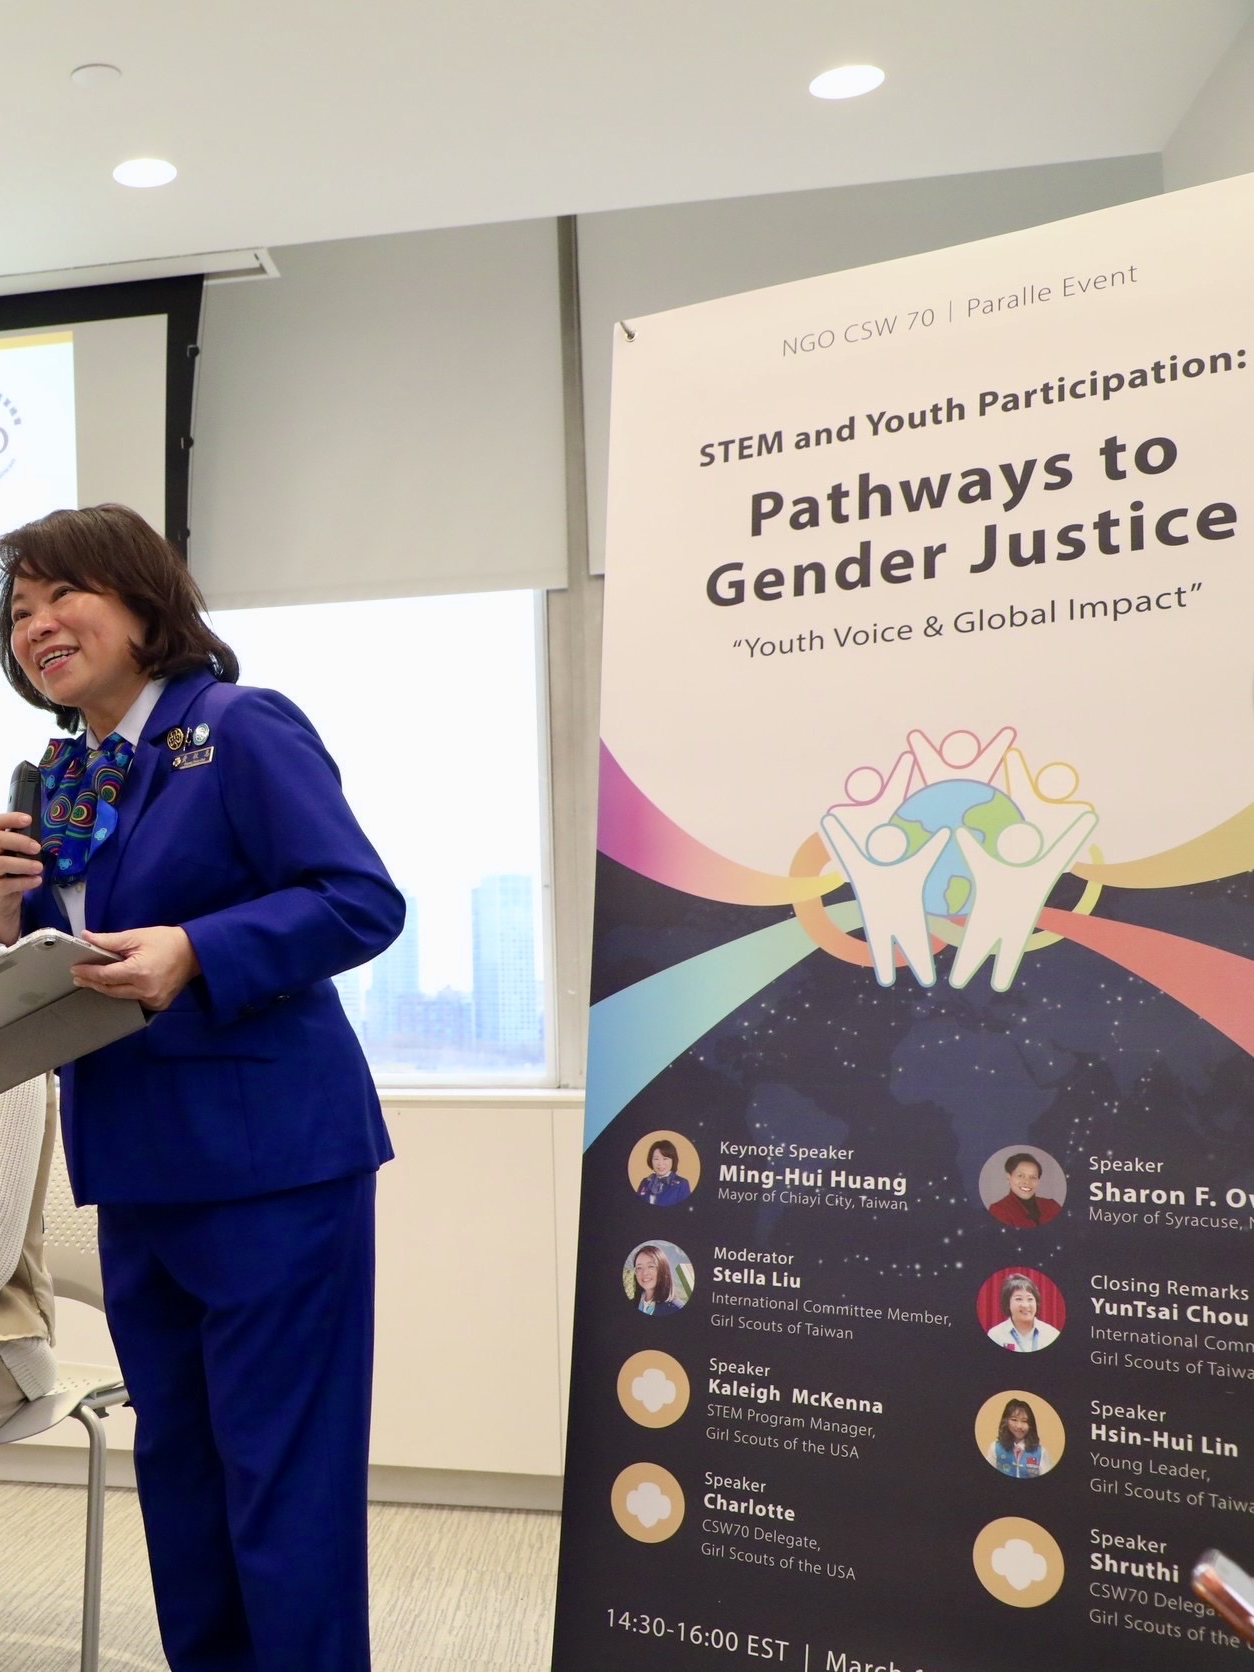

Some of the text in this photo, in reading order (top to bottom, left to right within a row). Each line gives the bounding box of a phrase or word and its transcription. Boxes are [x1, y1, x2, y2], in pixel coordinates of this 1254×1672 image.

[783, 330, 834, 356] NGO
[844, 316, 897, 343] CSW
[908, 309, 934, 329] 70
[969, 285, 1051, 317] Paralle
[1064, 266, 1137, 296] Event
[700, 350, 1246, 467] STEM and Youth Participation:
[752, 436, 1177, 537] Pathways to
[707, 501, 1237, 606] Gender Justice
[834, 624, 912, 647] Voice
[924, 616, 943, 637] &
[954, 600, 1055, 633] Global
[720, 1141, 854, 1160] Keynote Speaker
[1090, 1157, 1163, 1173] Speaker
[719, 1165, 907, 1196] Ming-Hui Huang
[719, 1188, 908, 1210] Mayor of Chiayi City, Taiwan
[1090, 1182, 1254, 1209] Sharon F. O
[1090, 1207, 1138, 1225] Mayor
[1144, 1211, 1160, 1224] of
[1166, 1212, 1242, 1230] Syracuse,
[714, 1247, 794, 1264] Moderator
[713, 1267, 800, 1288] Stella Liu
[1091, 1275, 1248, 1300] Closing Remarks
[713, 1292, 951, 1327] International Committee Member,
[1091, 1298, 1248, 1326] YunTsai Chou
[711, 1314, 852, 1339] Girl Scouts of Taiwan
[1092, 1326, 1197, 1347] International
[710, 1358, 770, 1376] Speaker
[1091, 1351, 1254, 1380] Girl Scouts of Taiwa
[709, 1379, 882, 1413] Kaleigh McKenna
[708, 1404, 875, 1438] STEM Program Manager,
[1091, 1401, 1166, 1422] Speaker
[706, 1427, 858, 1458] Girl Scouts of the USA
[1092, 1424, 1237, 1457] Hsin-Hui Lin
[1090, 1452, 1210, 1482] Young Leader,
[705, 1472, 766, 1492] Speaker
[1090, 1478, 1117, 1494] Girl
[1125, 1483, 1180, 1503] Scouts
[1187, 1492, 1204, 1506] of
[704, 1493, 795, 1521] Charlotte
[703, 1519, 820, 1551] CSW70 Delegate,
[1091, 1529, 1166, 1553] Speaker
[702, 1543, 855, 1580] Girl Scouts of the USA
[1091, 1553, 1178, 1582] Shruthi
[1090, 1583, 1220, 1619] CSW70 Delega
[607, 1607, 739, 1652] 14:30-16:00
[748, 1635, 789, 1661] EST
[1090, 1609, 1117, 1626] Girl
[1125, 1615, 1181, 1637] Scouts
[1188, 1628, 1206, 1643] of
[1210, 1629, 1240, 1649] the
